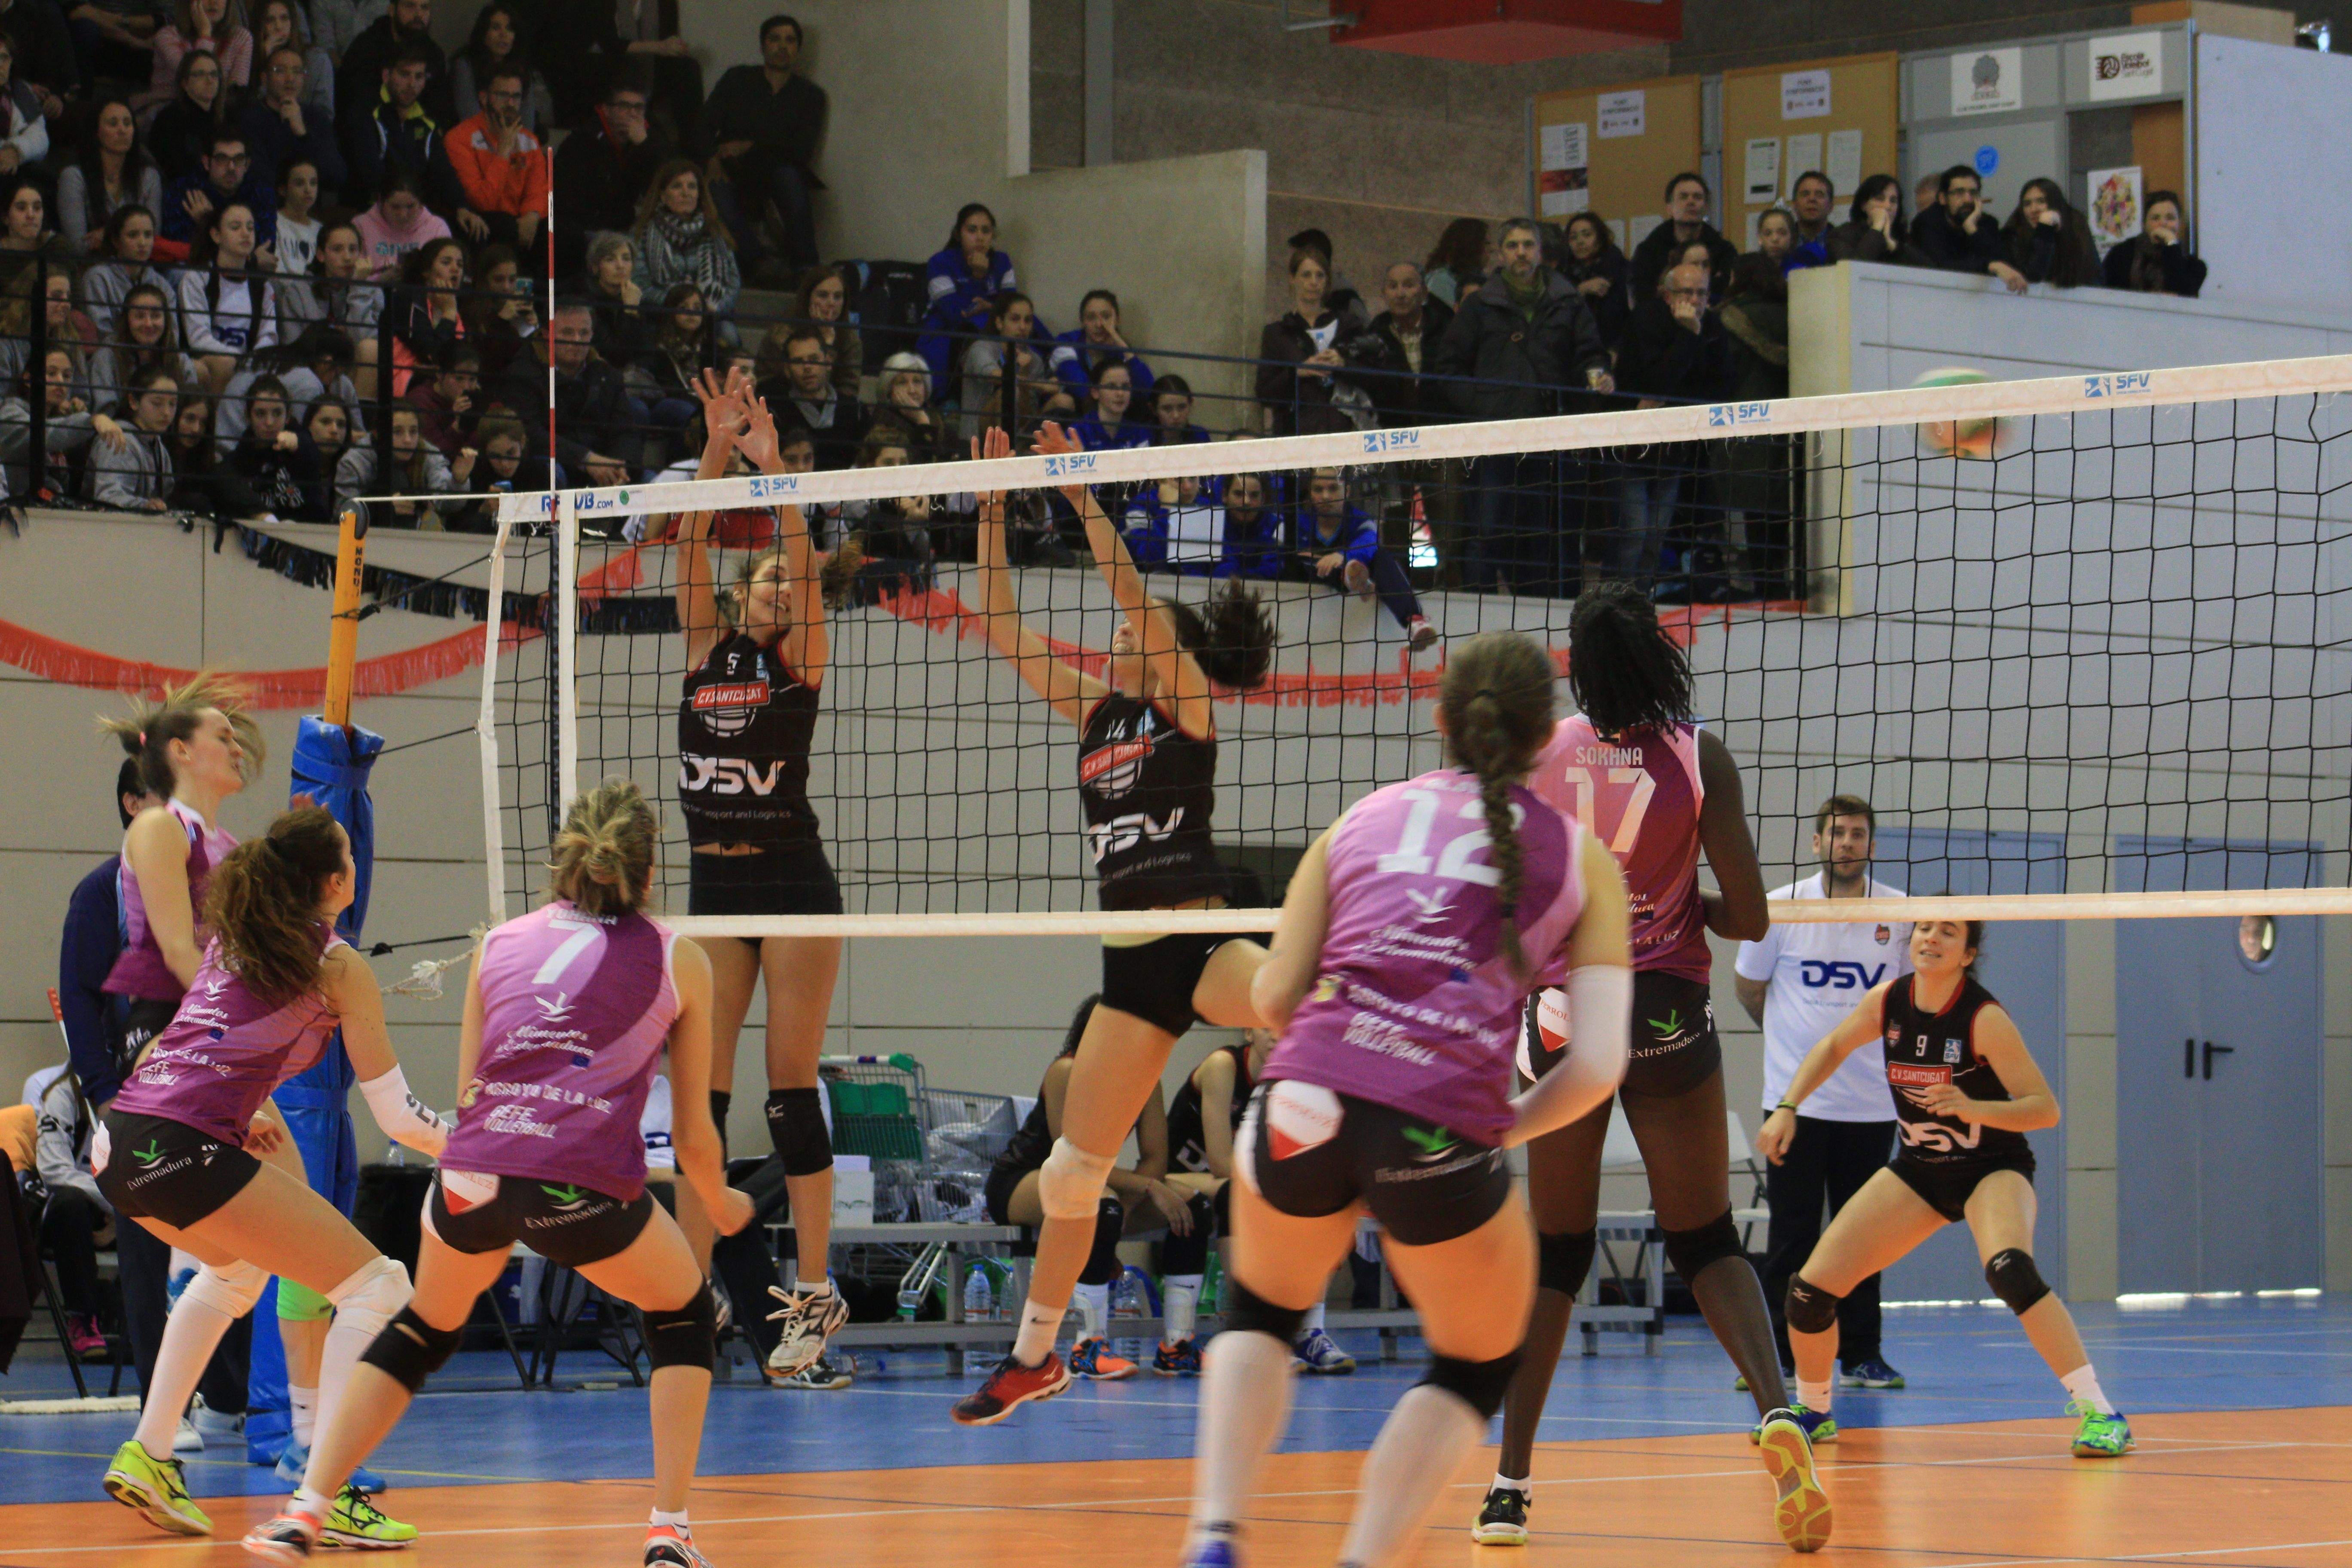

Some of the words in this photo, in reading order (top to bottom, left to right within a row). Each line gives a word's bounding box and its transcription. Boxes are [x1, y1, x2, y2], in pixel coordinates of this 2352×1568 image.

[2116, 373, 2150, 389] SFV
[1738, 402, 1770, 418] SFV
[1390, 430, 1419, 445] SFV
[1069, 455, 1096, 469] SFV
[772, 476, 798, 490] SFV
[726, 652, 741, 675] 5
[1575, 746, 1643, 766] SOKHNA
[679, 751, 787, 796] DSV
[1565, 767, 1657, 853] 17
[1376, 788, 1526, 888] 12
[531, 919, 601, 985] 7
[1800, 960, 1886, 990] DSV
[1627, 1032, 1700, 1059] Extremadura
[1915, 1035, 1928, 1057] 9
[542, 1084, 563, 1101] DE
